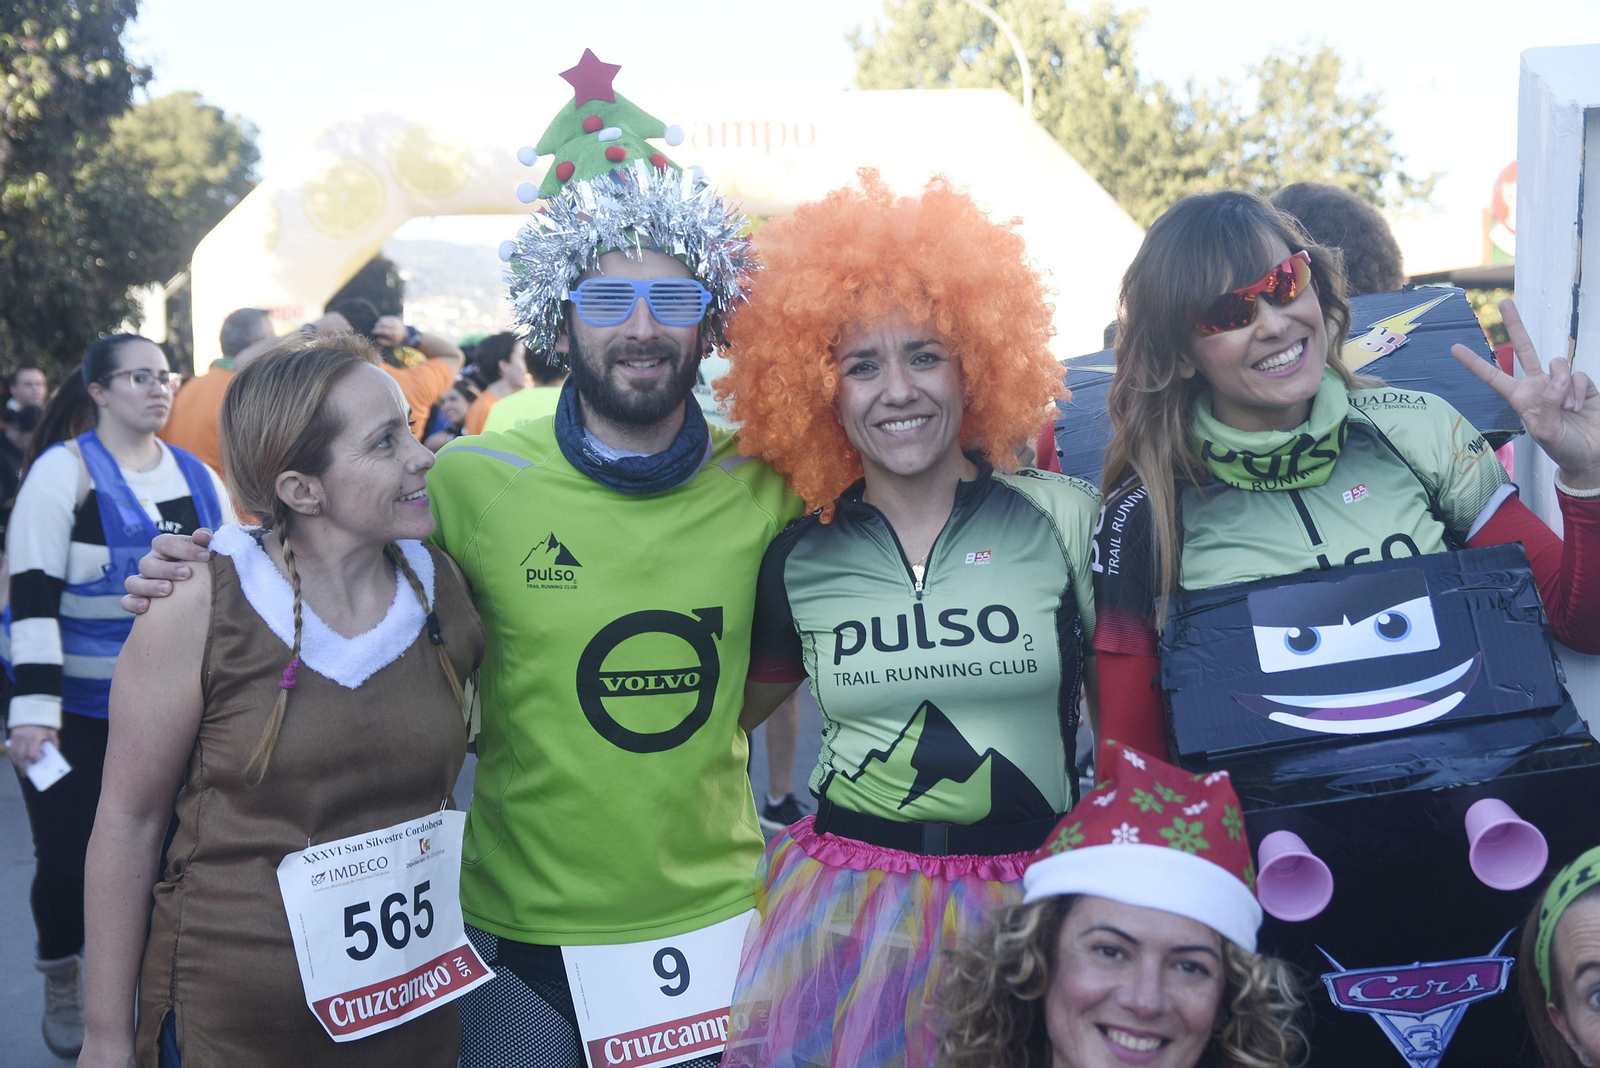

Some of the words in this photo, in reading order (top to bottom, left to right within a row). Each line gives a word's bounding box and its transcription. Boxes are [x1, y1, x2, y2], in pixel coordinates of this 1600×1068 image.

[1108, 537, 1122, 575] TRAIL
[599, 672, 701, 692] VOLVO
[833, 670, 881, 687] TRAIL
[885, 662, 983, 683] RUNNING
[989, 658, 1038, 675] CLUB
[302, 847, 342, 865] XXXVI
[345, 843, 364, 854] San
[366, 832, 403, 849] Silvestre
[405, 818, 443, 837] Cordobesa
[329, 856, 389, 882] IMDECO
[344, 880, 434, 961] 565
[653, 947, 691, 997] 9
[1348, 974, 1485, 1002] Cars
[329, 965, 451, 1027] Cruzcampo
[453, 956, 472, 978] SIN
[1402, 1023, 1443, 1060] 3
